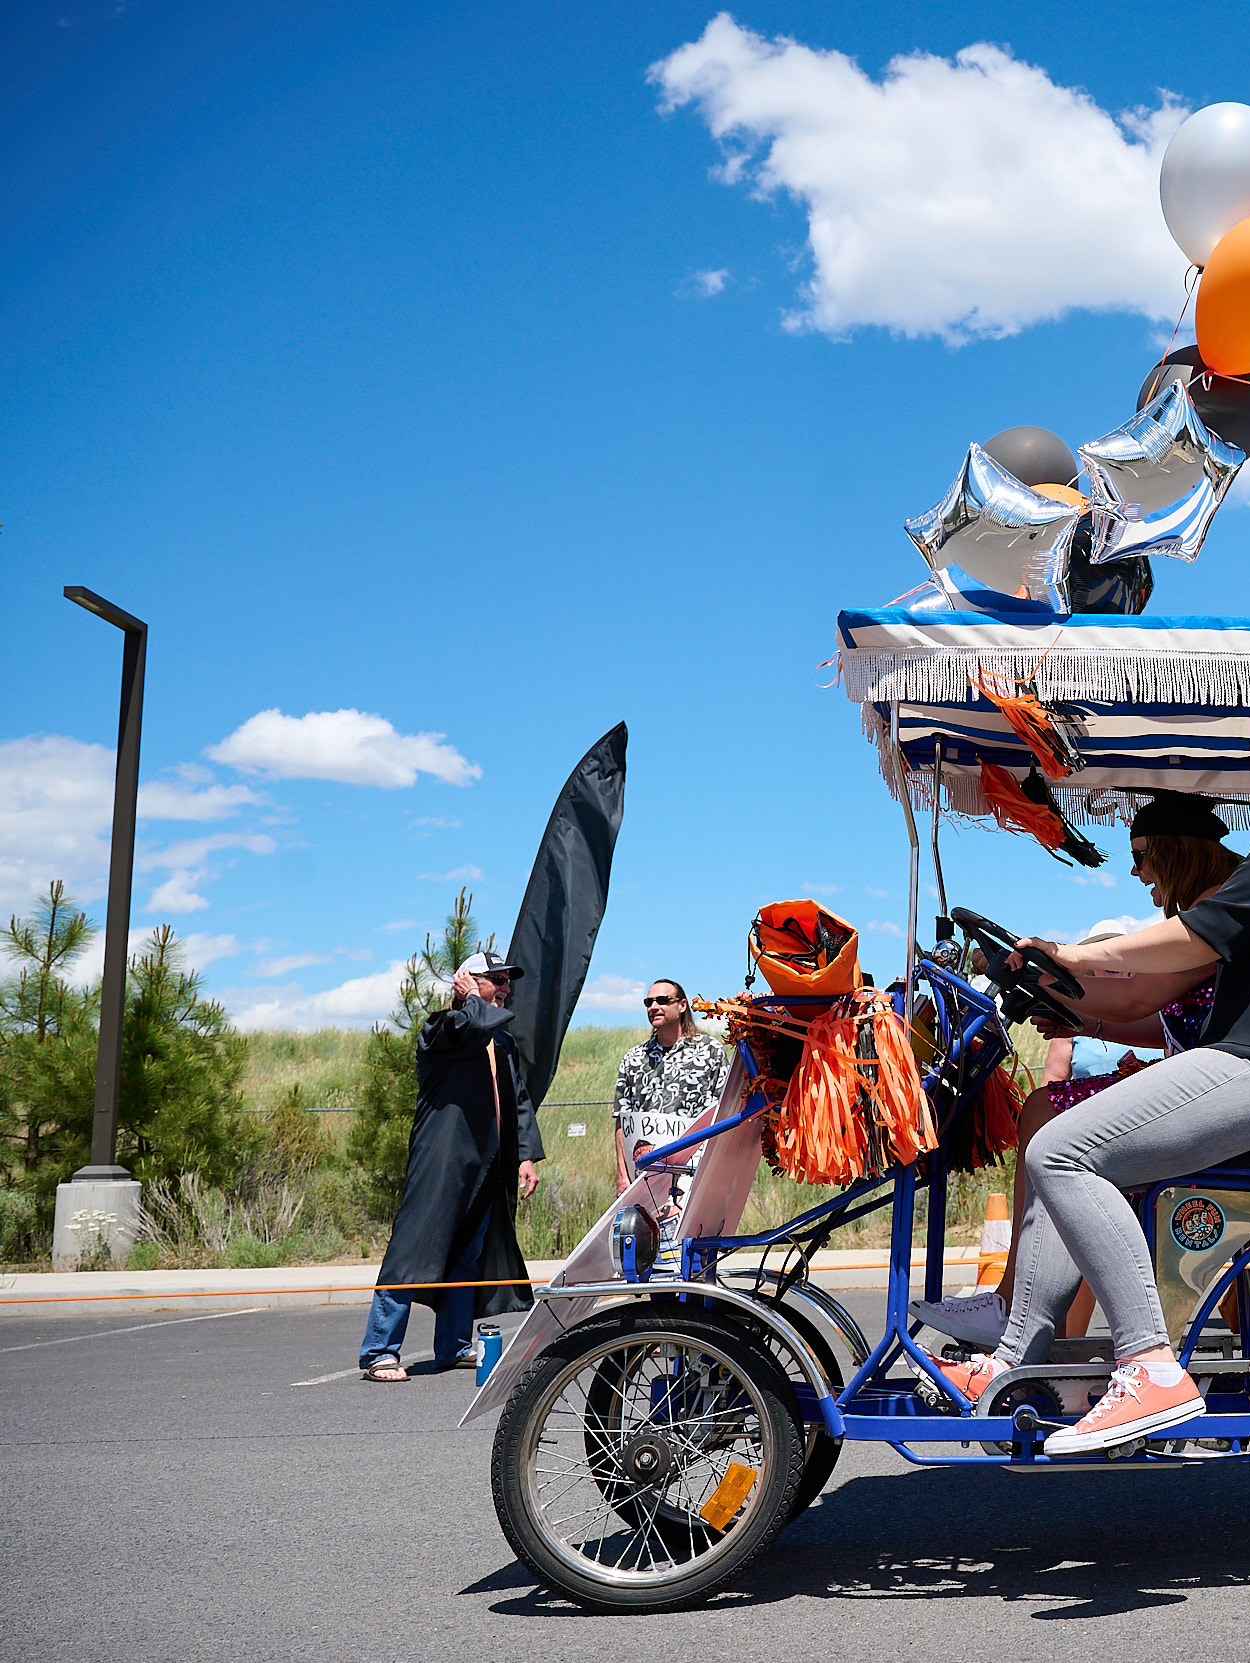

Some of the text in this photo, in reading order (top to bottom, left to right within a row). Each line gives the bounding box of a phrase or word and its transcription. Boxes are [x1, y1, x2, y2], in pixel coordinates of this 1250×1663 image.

[622, 1116, 687, 1138] GO BEND
[1175, 1200, 1222, 1224] WHEEL FUN
[1174, 1227, 1220, 1249] RENTALS
